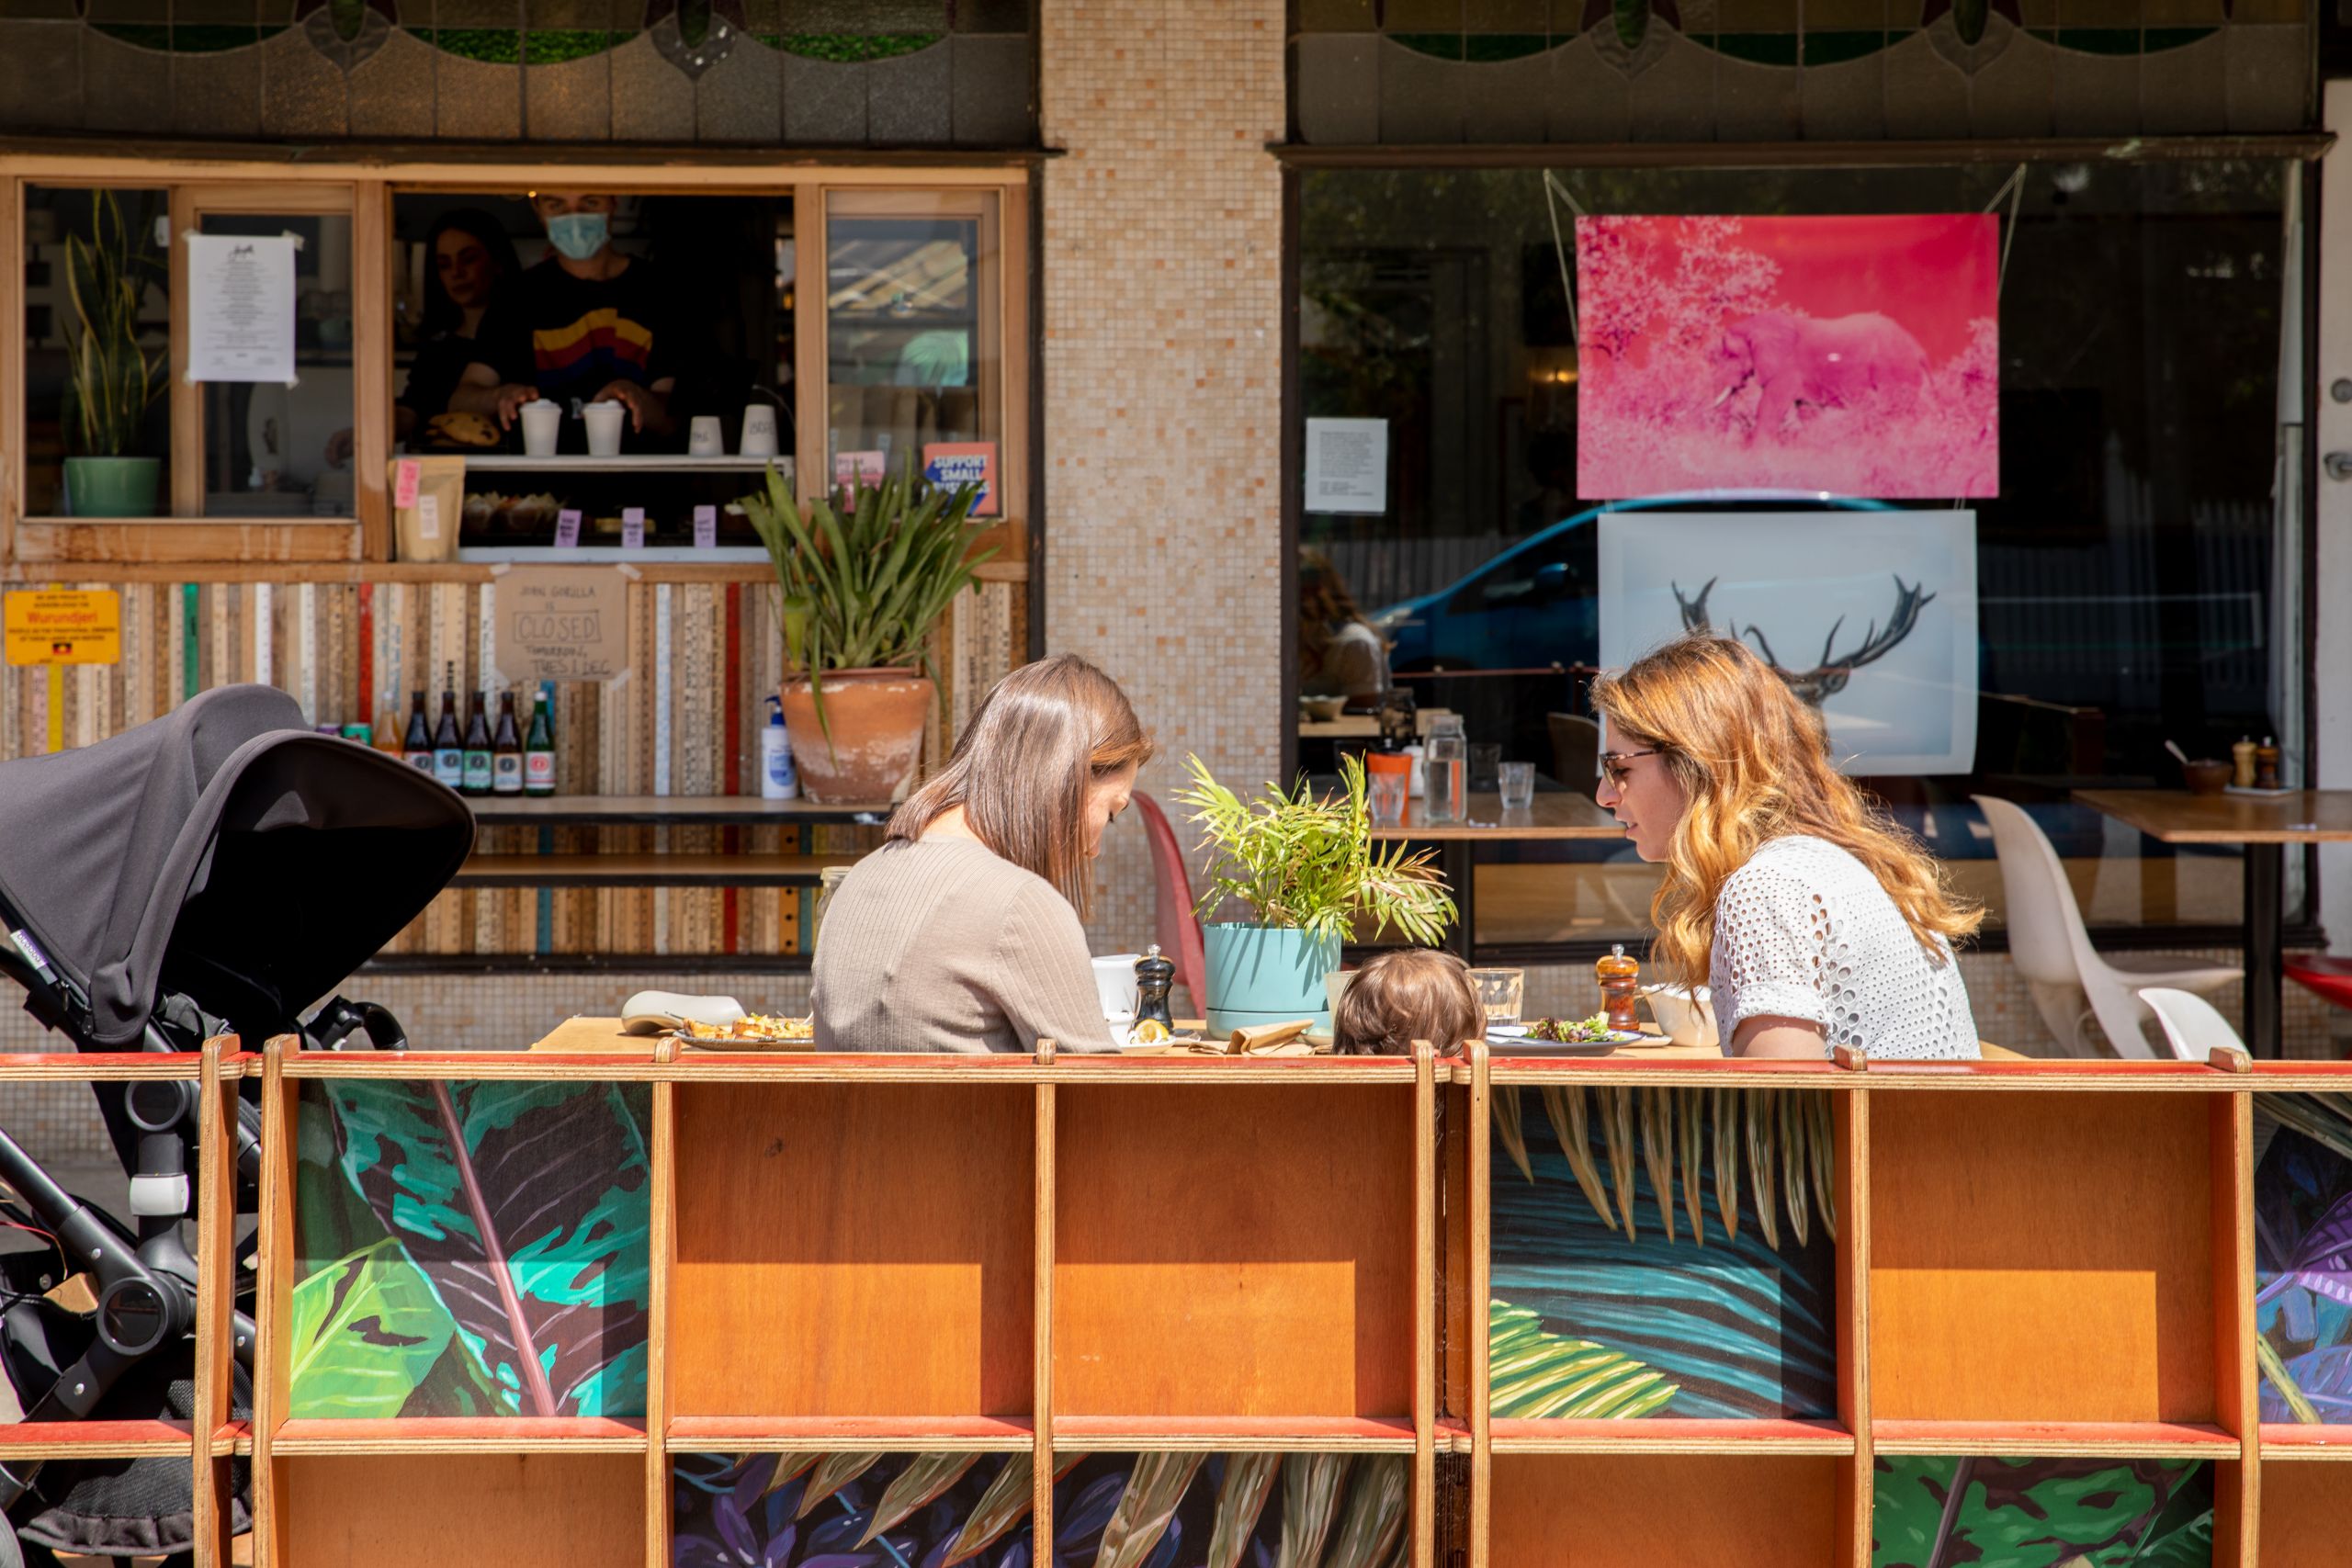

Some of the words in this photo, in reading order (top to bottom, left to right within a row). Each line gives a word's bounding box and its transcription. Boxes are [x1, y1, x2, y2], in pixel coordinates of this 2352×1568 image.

[933, 455, 988, 468] SUPPORT
[941, 468, 982, 481] SMALL
[552, 586, 595, 598] GORILLA
[27, 611, 97, 626] Wurundjeri
[518, 615, 596, 642] CLOSED
[530, 659, 569, 674] TUES
